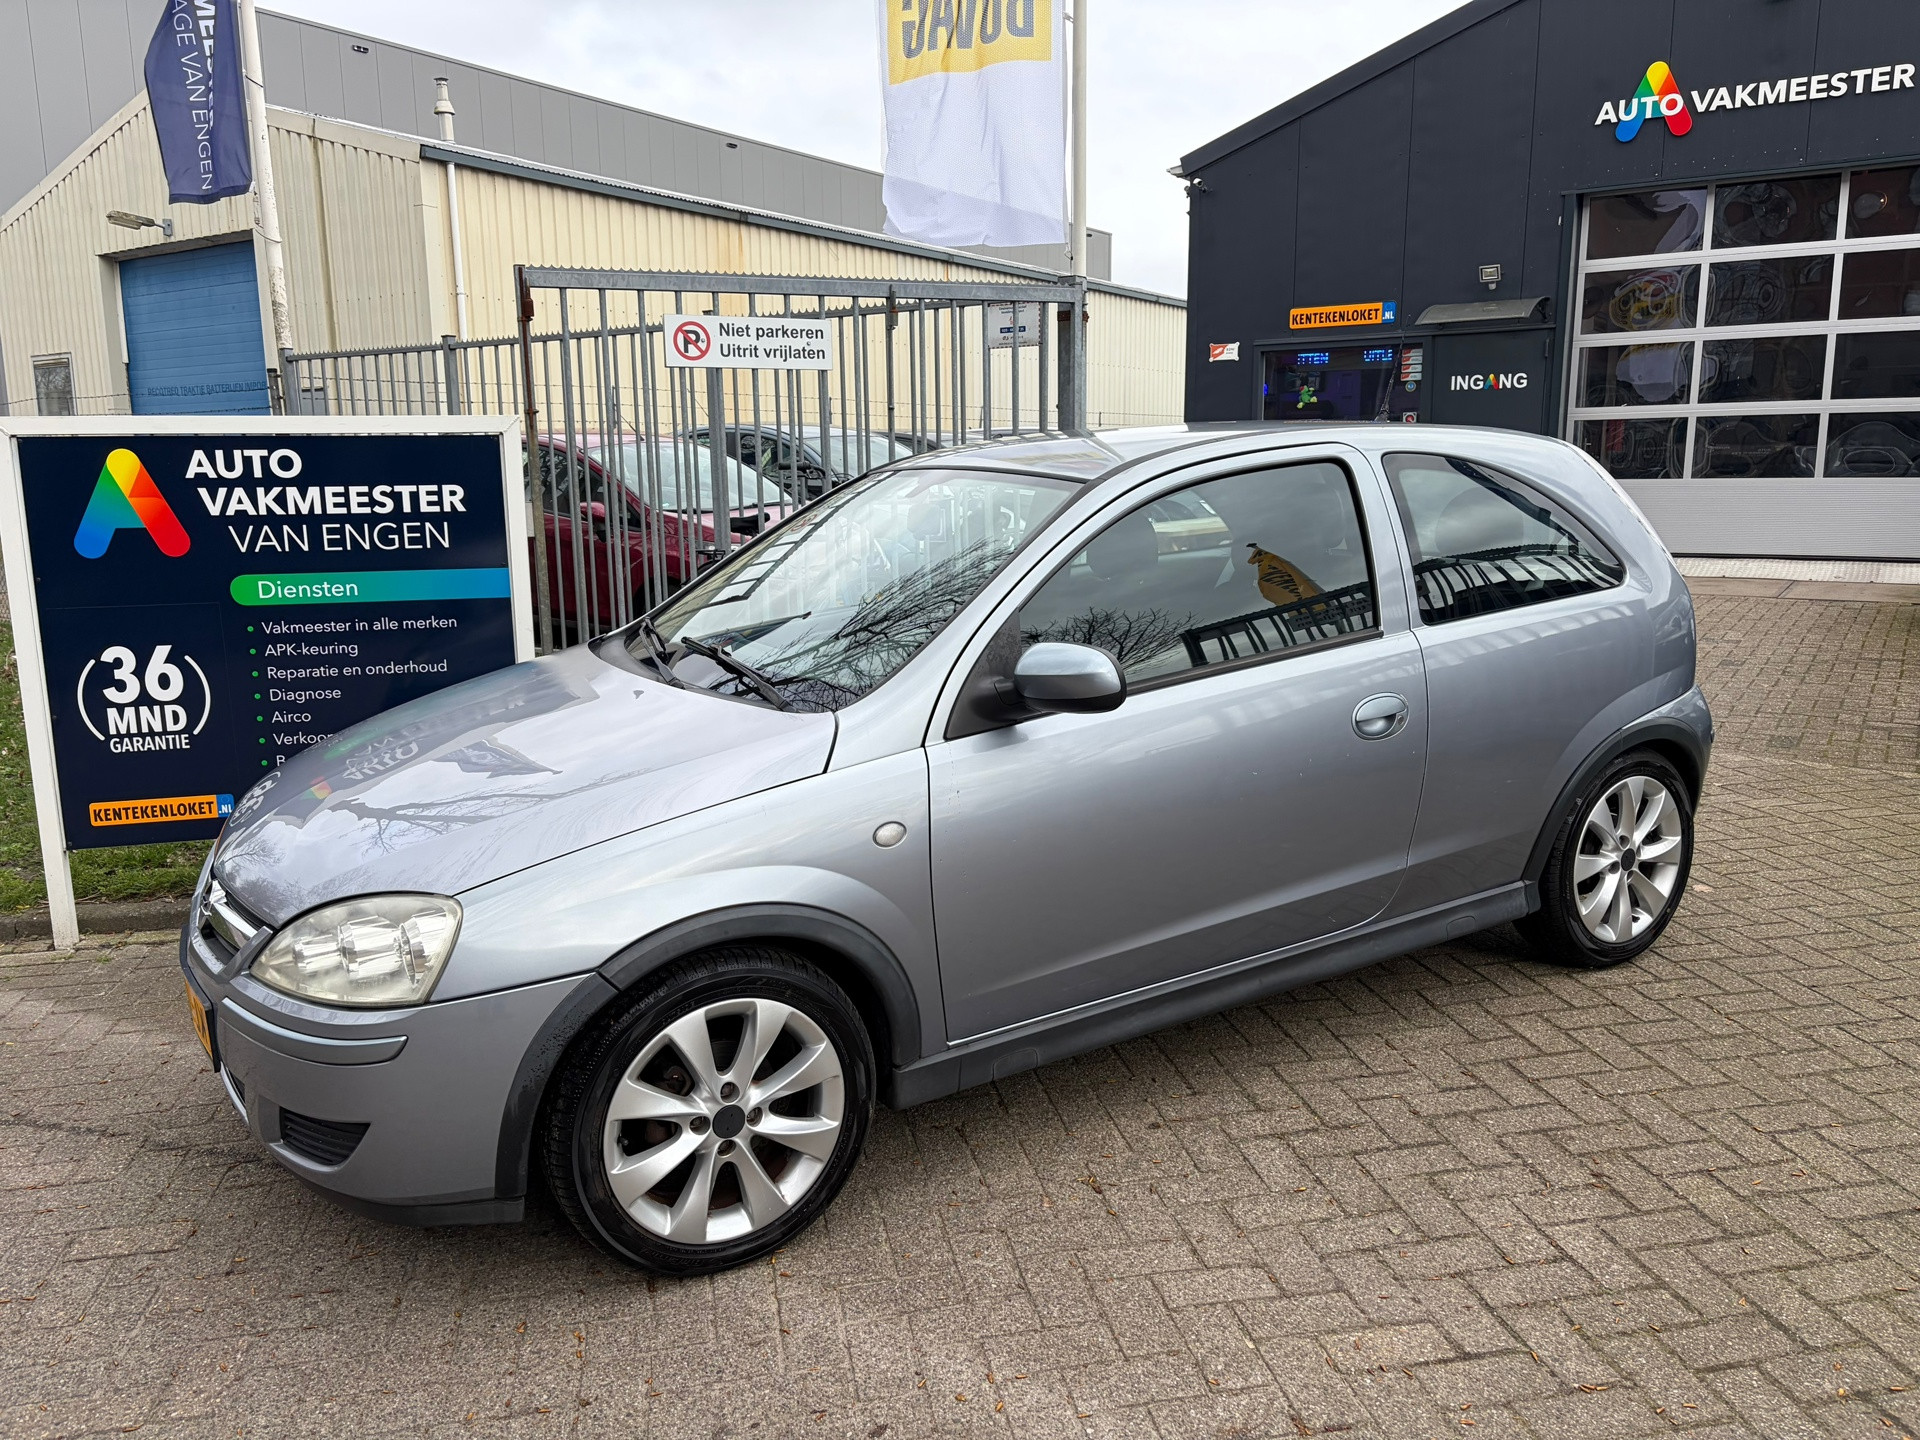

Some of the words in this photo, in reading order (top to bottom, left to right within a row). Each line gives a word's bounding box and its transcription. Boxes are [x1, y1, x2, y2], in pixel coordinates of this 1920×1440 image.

[181, 52, 207, 101] VAN
[1594, 93, 1684, 126] AUTO
[1690, 63, 1916, 113] VAKMEESTER
[192, 110, 213, 190] ENGEN
[719, 322, 751, 337] Niet
[756, 325, 824, 341] parkeren
[720, 343, 759, 358] Uitrit
[763, 345, 826, 362] vrijlaten
[1450, 373, 1528, 391] INGANG
[185, 448, 303, 480] AUTO
[197, 484, 467, 517] VAKMEESTER
[228, 524, 310, 553] VAN
[321, 521, 451, 552] ENGEN
[257, 580, 360, 599] Diensten
[261, 620, 351, 634] Vakmeester
[355, 618, 369, 631] in
[373, 616, 399, 631] alle
[402, 615, 458, 629] merken
[264, 642, 359, 658] APK-keuring
[100, 645, 184, 704] 36
[267, 664, 339, 682] Reparatie
[343, 663, 362, 676] en
[365, 658, 448, 675] onderhoud
[269, 688, 342, 704] Diagnose
[106, 704, 188, 735] MND
[271, 711, 312, 724] Airco
[109, 733, 191, 754] GARANTIE
